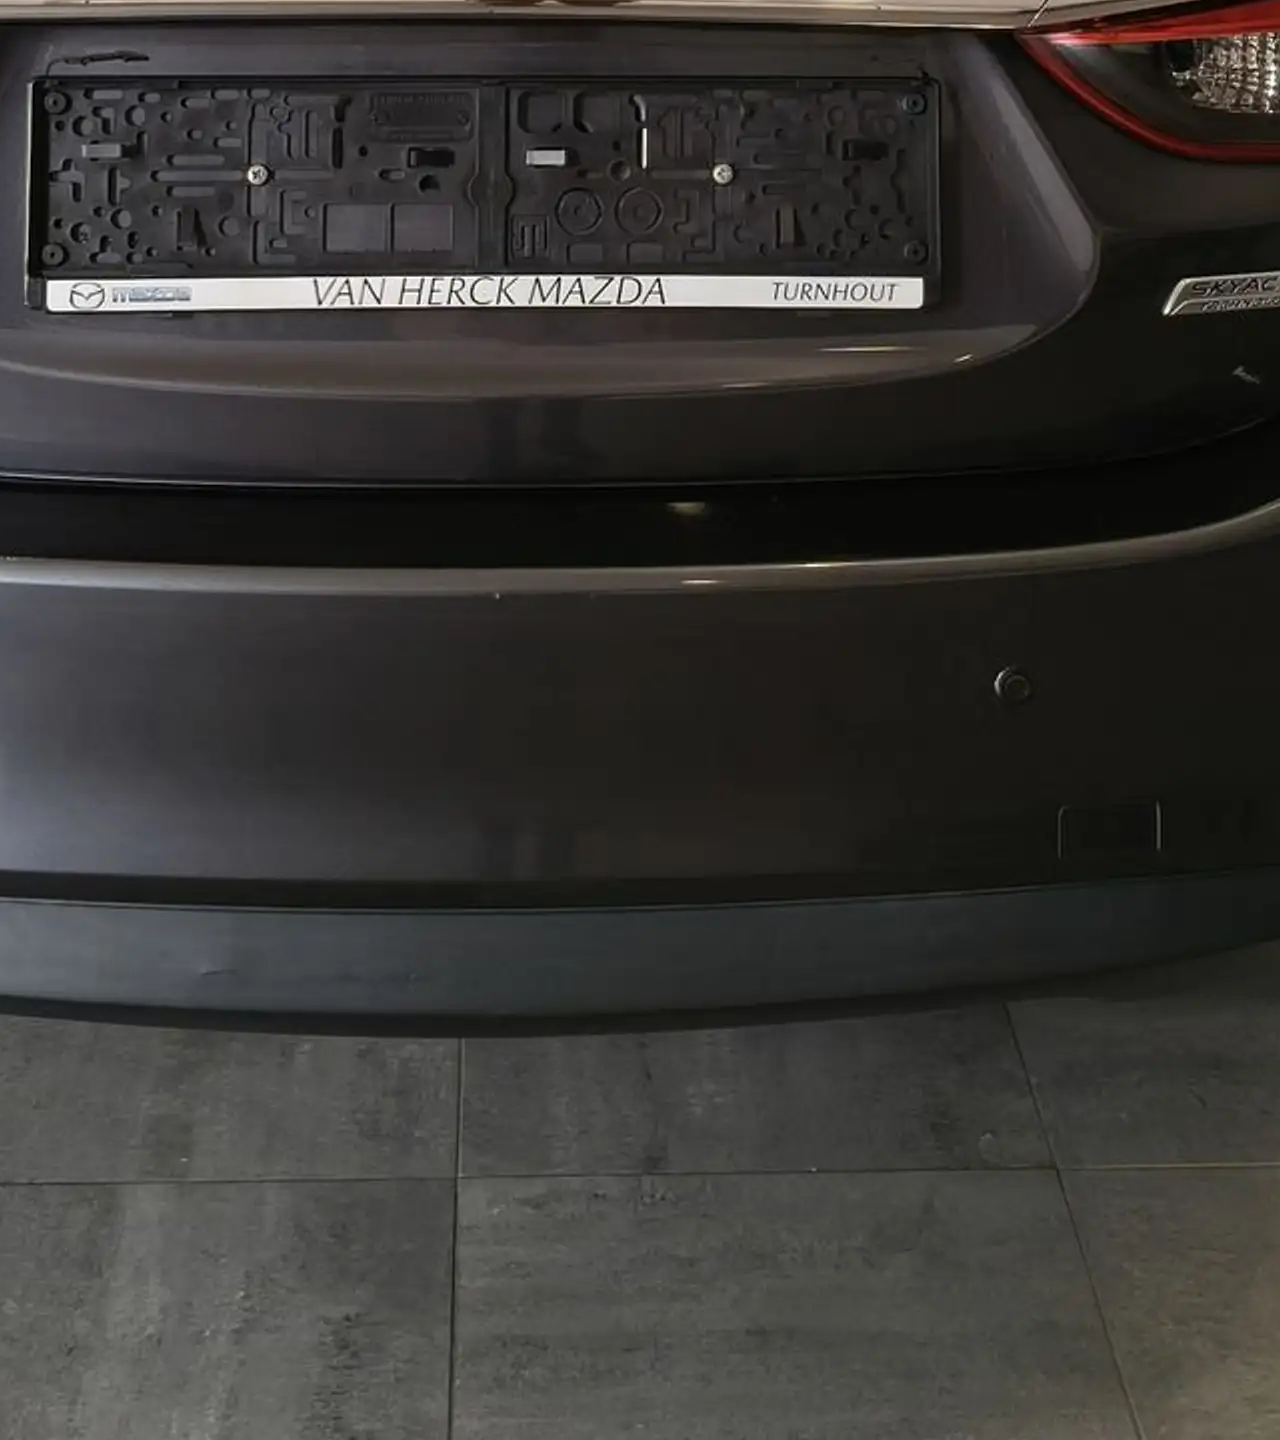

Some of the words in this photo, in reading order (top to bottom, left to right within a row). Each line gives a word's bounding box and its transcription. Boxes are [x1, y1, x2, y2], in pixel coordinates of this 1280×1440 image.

[313, 277, 386, 307] VAN
[397, 276, 521, 306] HERCK
[528, 276, 668, 306] MAZDA
[772, 282, 900, 302] TURNHOUT
